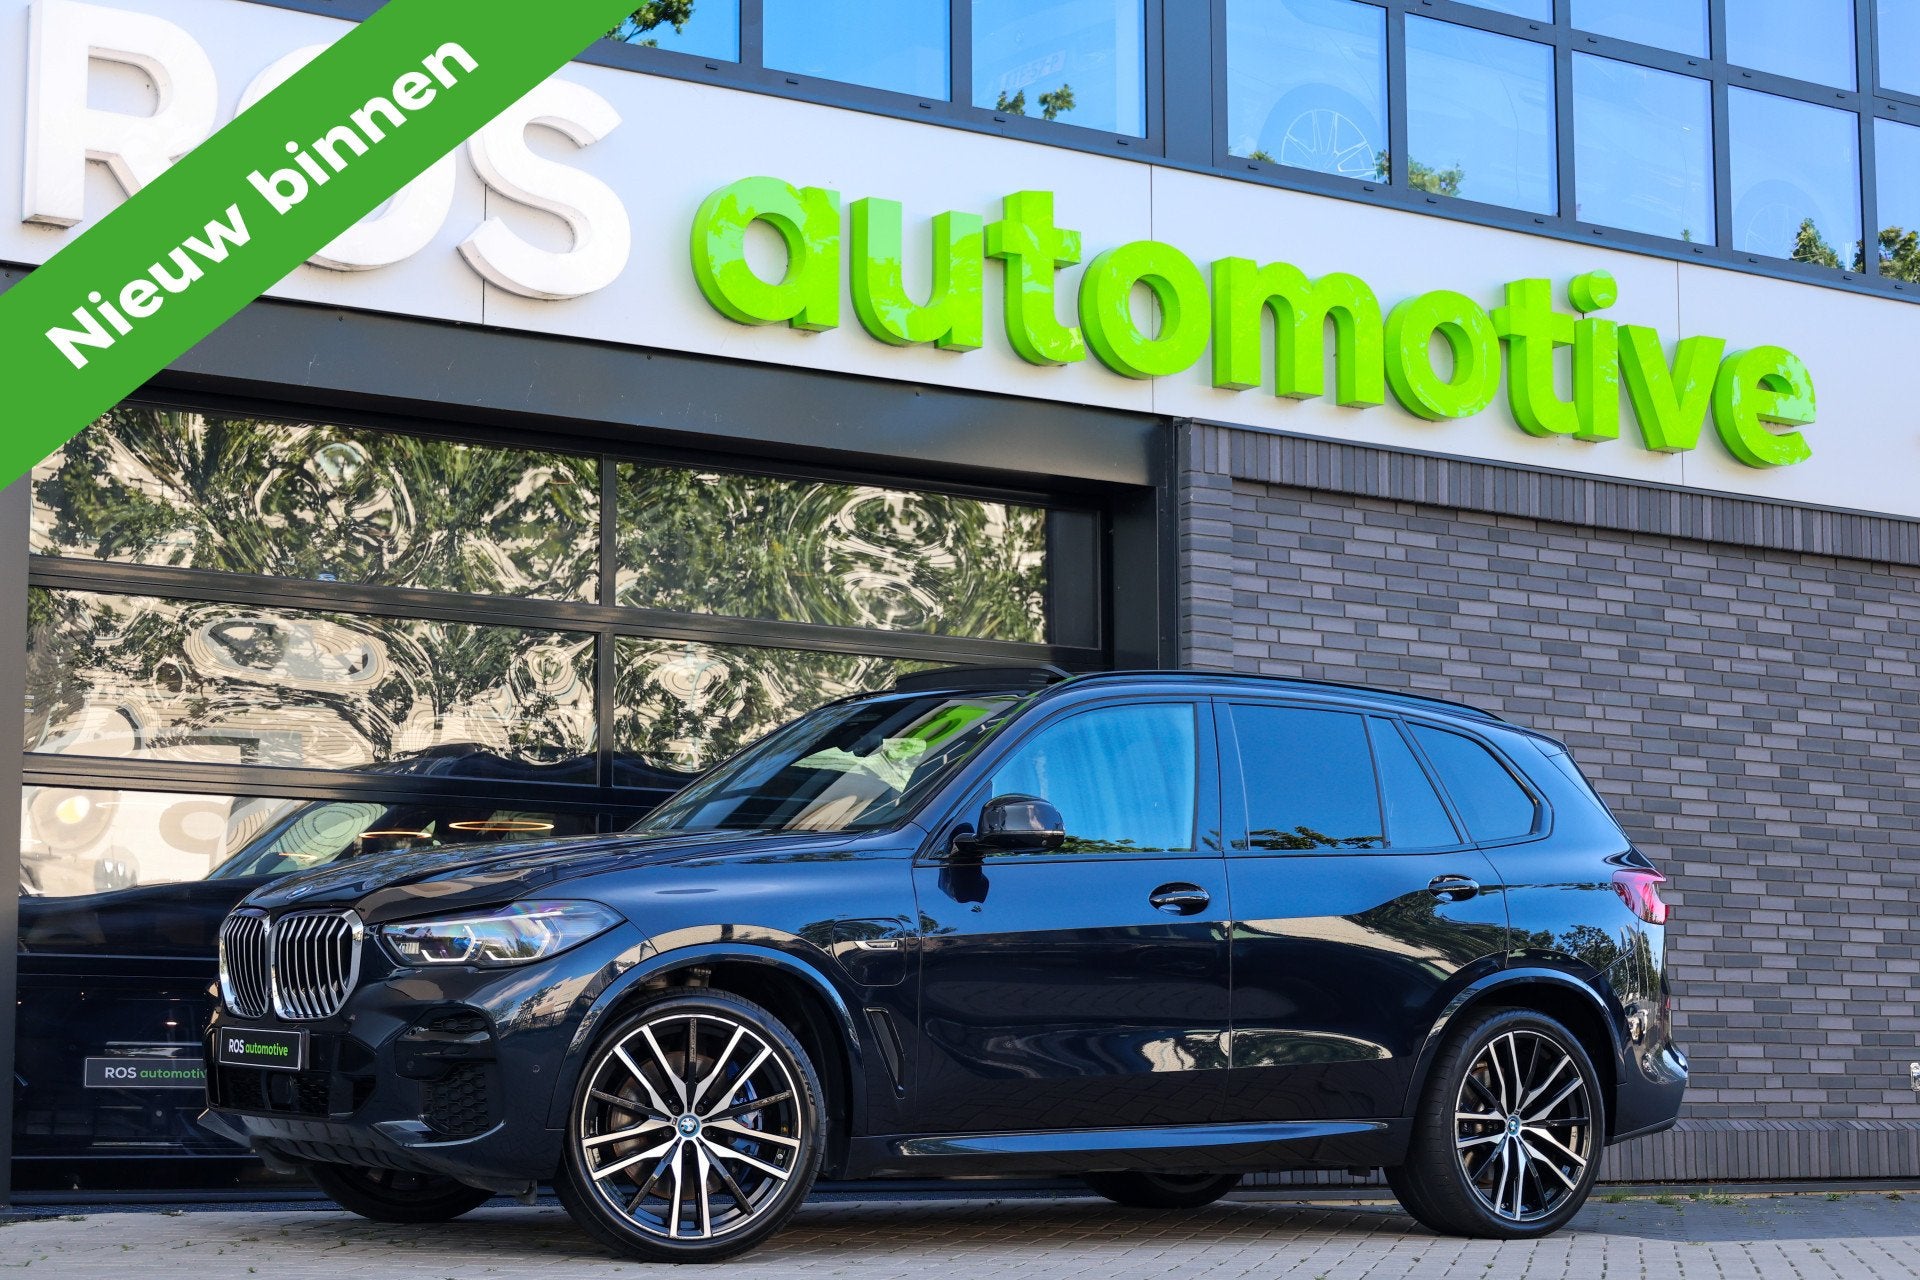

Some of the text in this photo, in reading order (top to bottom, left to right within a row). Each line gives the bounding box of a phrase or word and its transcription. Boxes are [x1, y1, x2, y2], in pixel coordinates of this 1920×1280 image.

[690, 176, 1816, 469] automotive
[229, 1038, 289, 1056] ROS automotive
[105, 1067, 207, 1079] ROS automotiv
